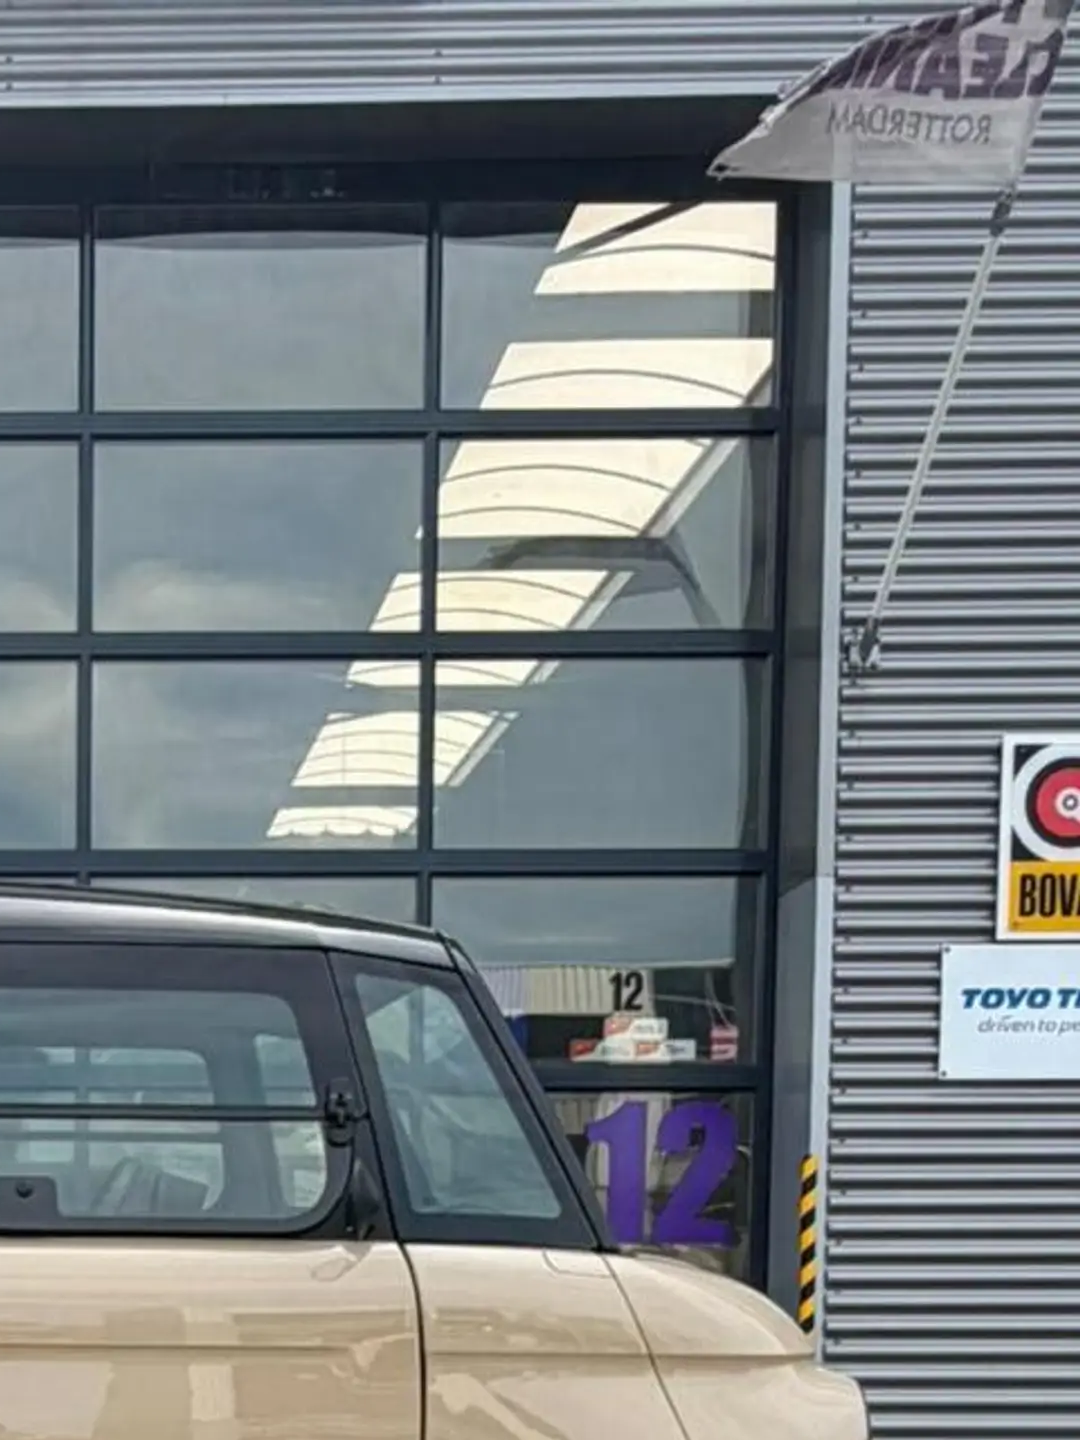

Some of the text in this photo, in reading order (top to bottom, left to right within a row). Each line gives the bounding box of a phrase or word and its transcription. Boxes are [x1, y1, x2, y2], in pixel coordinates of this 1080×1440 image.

[1019, 873, 1080, 917] BOV
[609, 969, 644, 1012] 12
[961, 987, 1051, 1009] TOYO
[978, 1015, 1035, 1033] driven
[1038, 1018, 1057, 1032] to
[586, 1102, 742, 1246] 12
